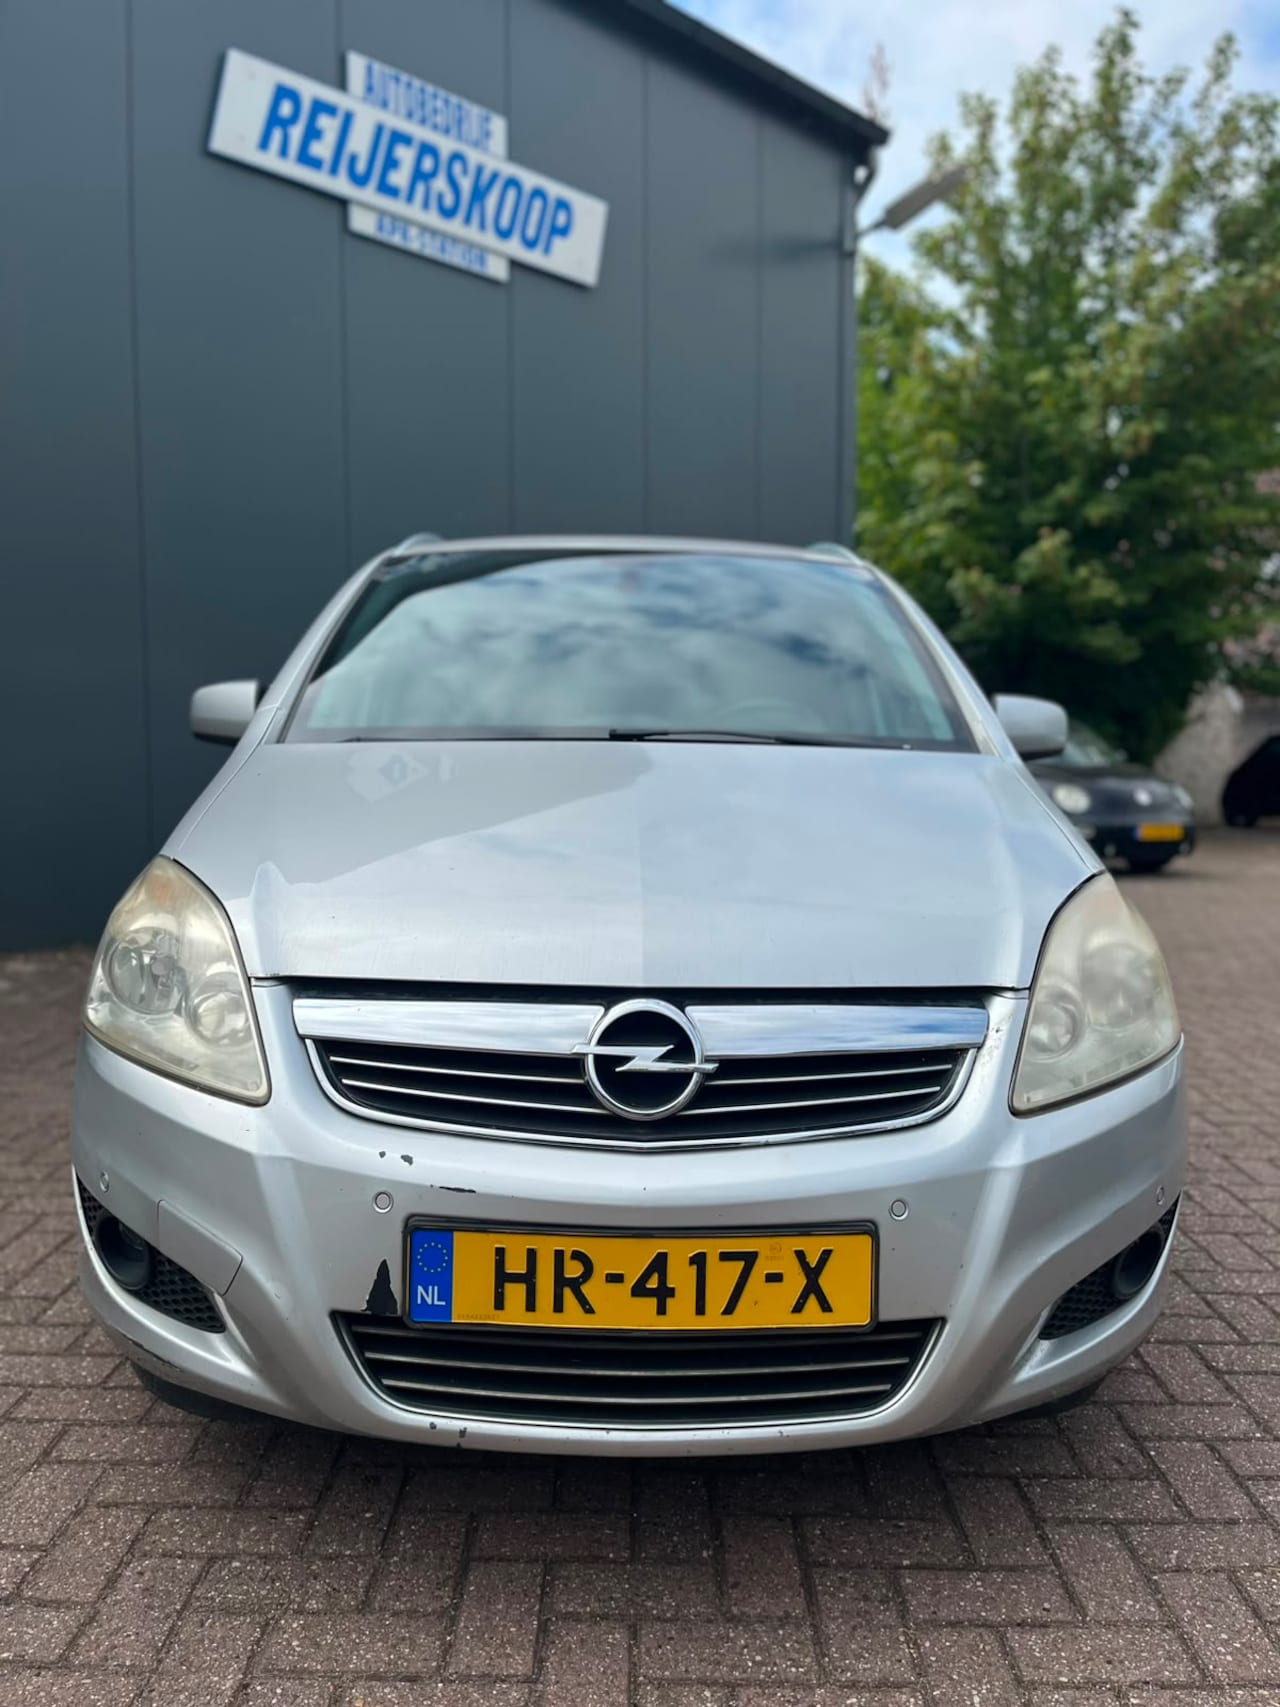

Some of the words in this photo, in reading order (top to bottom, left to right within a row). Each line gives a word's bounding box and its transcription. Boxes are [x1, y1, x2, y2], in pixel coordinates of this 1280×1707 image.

[257, 82, 575, 257] REIJERSKOOP
[416, 1285, 446, 1306] NL
[492, 1245, 834, 1317] HR-417-X
